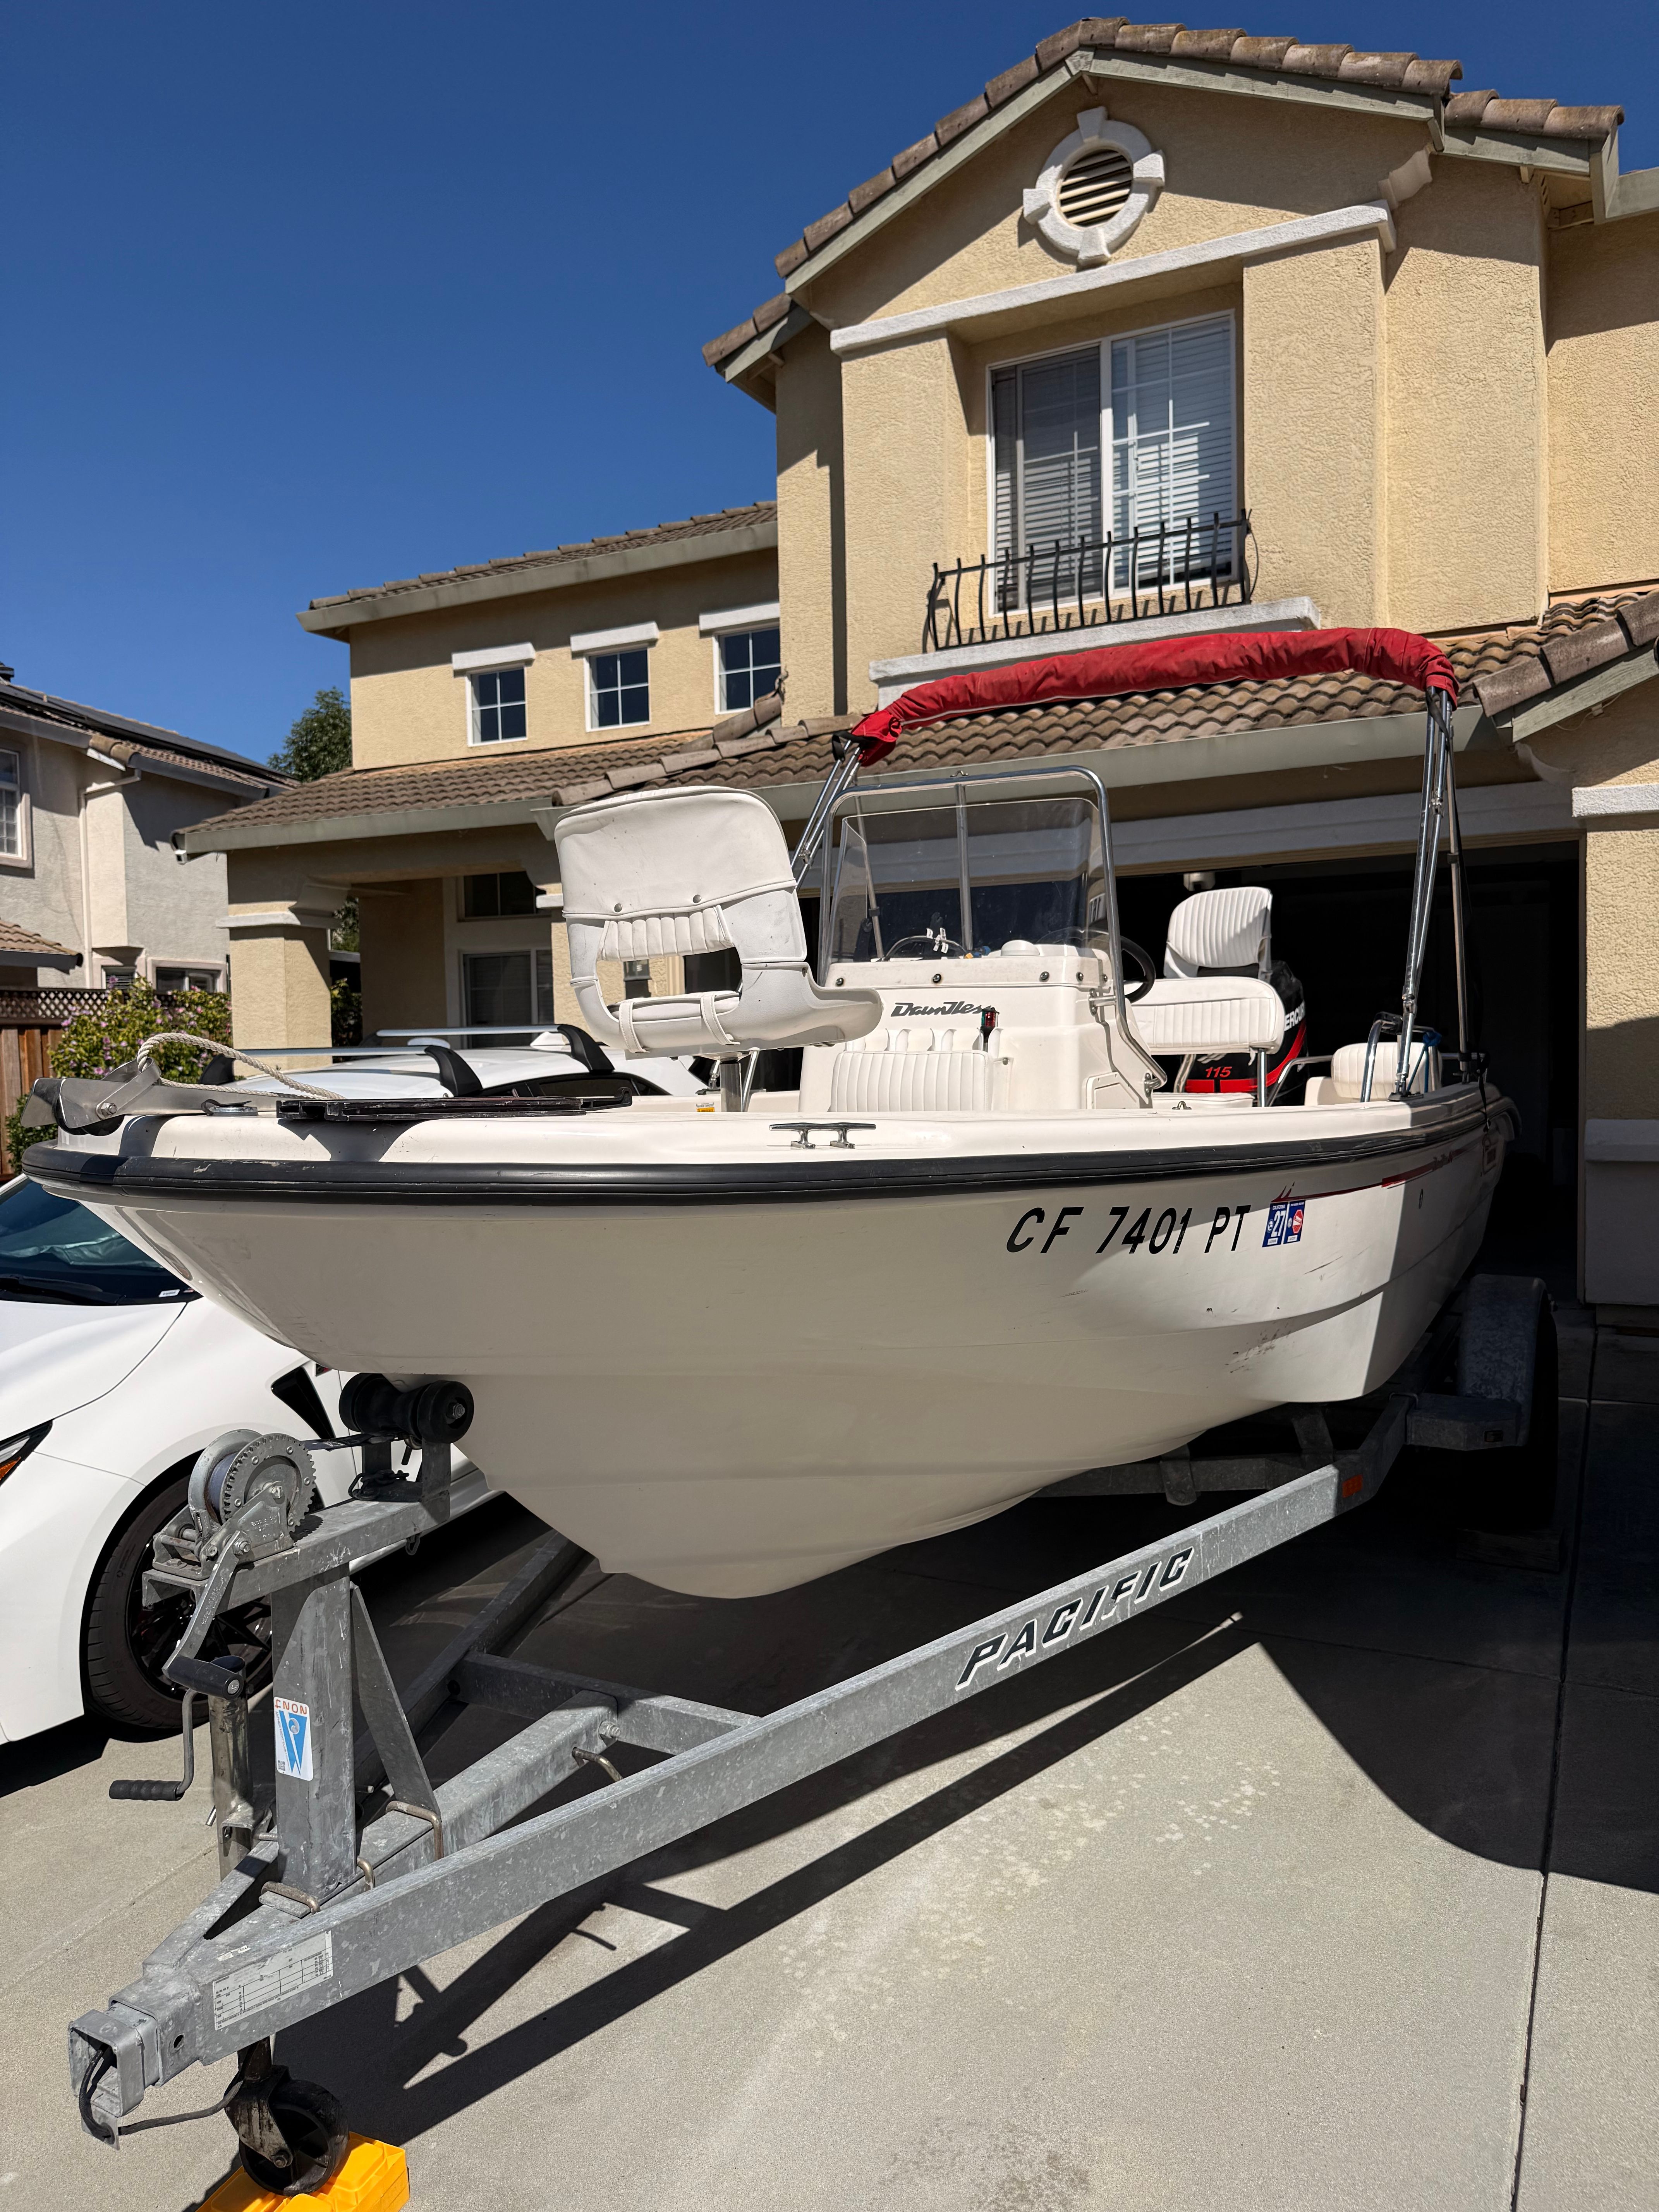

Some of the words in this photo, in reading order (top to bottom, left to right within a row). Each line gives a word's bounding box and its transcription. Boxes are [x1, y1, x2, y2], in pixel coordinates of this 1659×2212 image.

[1206, 1066, 1232, 1078] 115
[1006, 1206, 1084, 1254] CF
[1096, 1206, 1192, 1254] 7401
[1204, 1205, 1251, 1253] PT
[1271, 1210, 1286, 1237] 27
[955, 1546, 1194, 1691] PACIFIC
